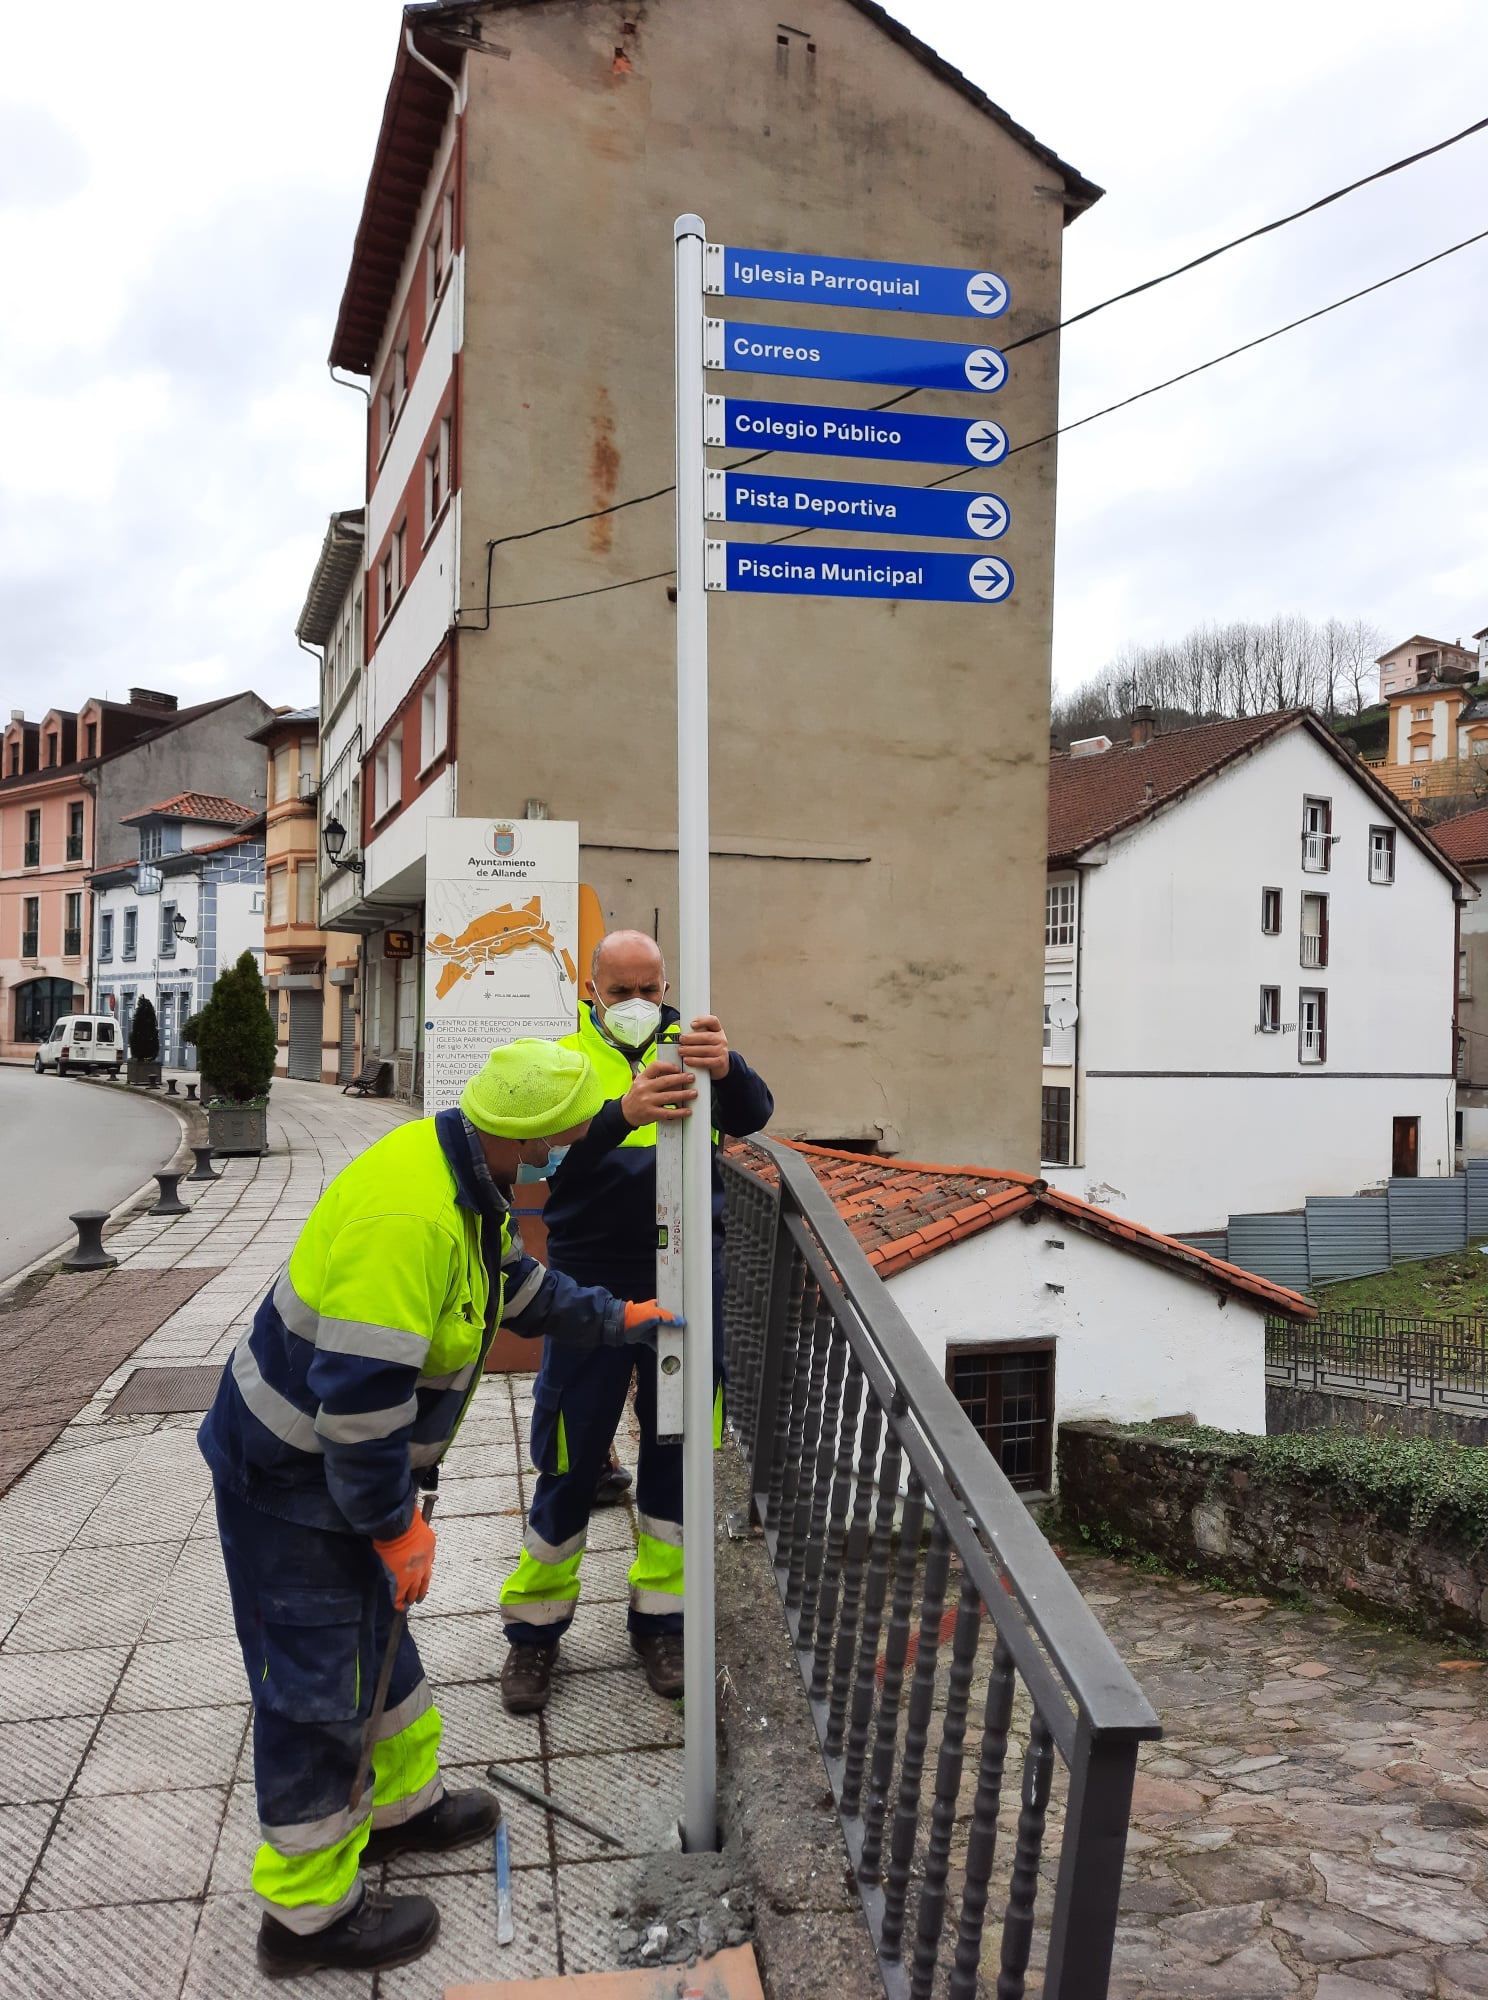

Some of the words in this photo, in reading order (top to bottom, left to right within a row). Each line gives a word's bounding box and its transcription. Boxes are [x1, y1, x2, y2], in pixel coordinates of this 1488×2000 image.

[734, 262, 805, 285] Iglesia
[811, 270, 921, 297] Parroquial
[733, 338, 821, 362] Correos
[735, 414, 818, 440] Colegio
[823, 422, 902, 445] Público
[736, 488, 789, 509] Pista
[795, 493, 897, 518] Deportiva
[738, 559, 816, 580] Piscina
[821, 563, 923, 588] Municipal
[467, 857, 536, 868] Ayuntamiento
[476, 868, 489, 877] de
[490, 868, 528, 878] Allande
[447, 1043, 461, 1051] siglo
[463, 1036, 507, 1044] PARROQUIAL
